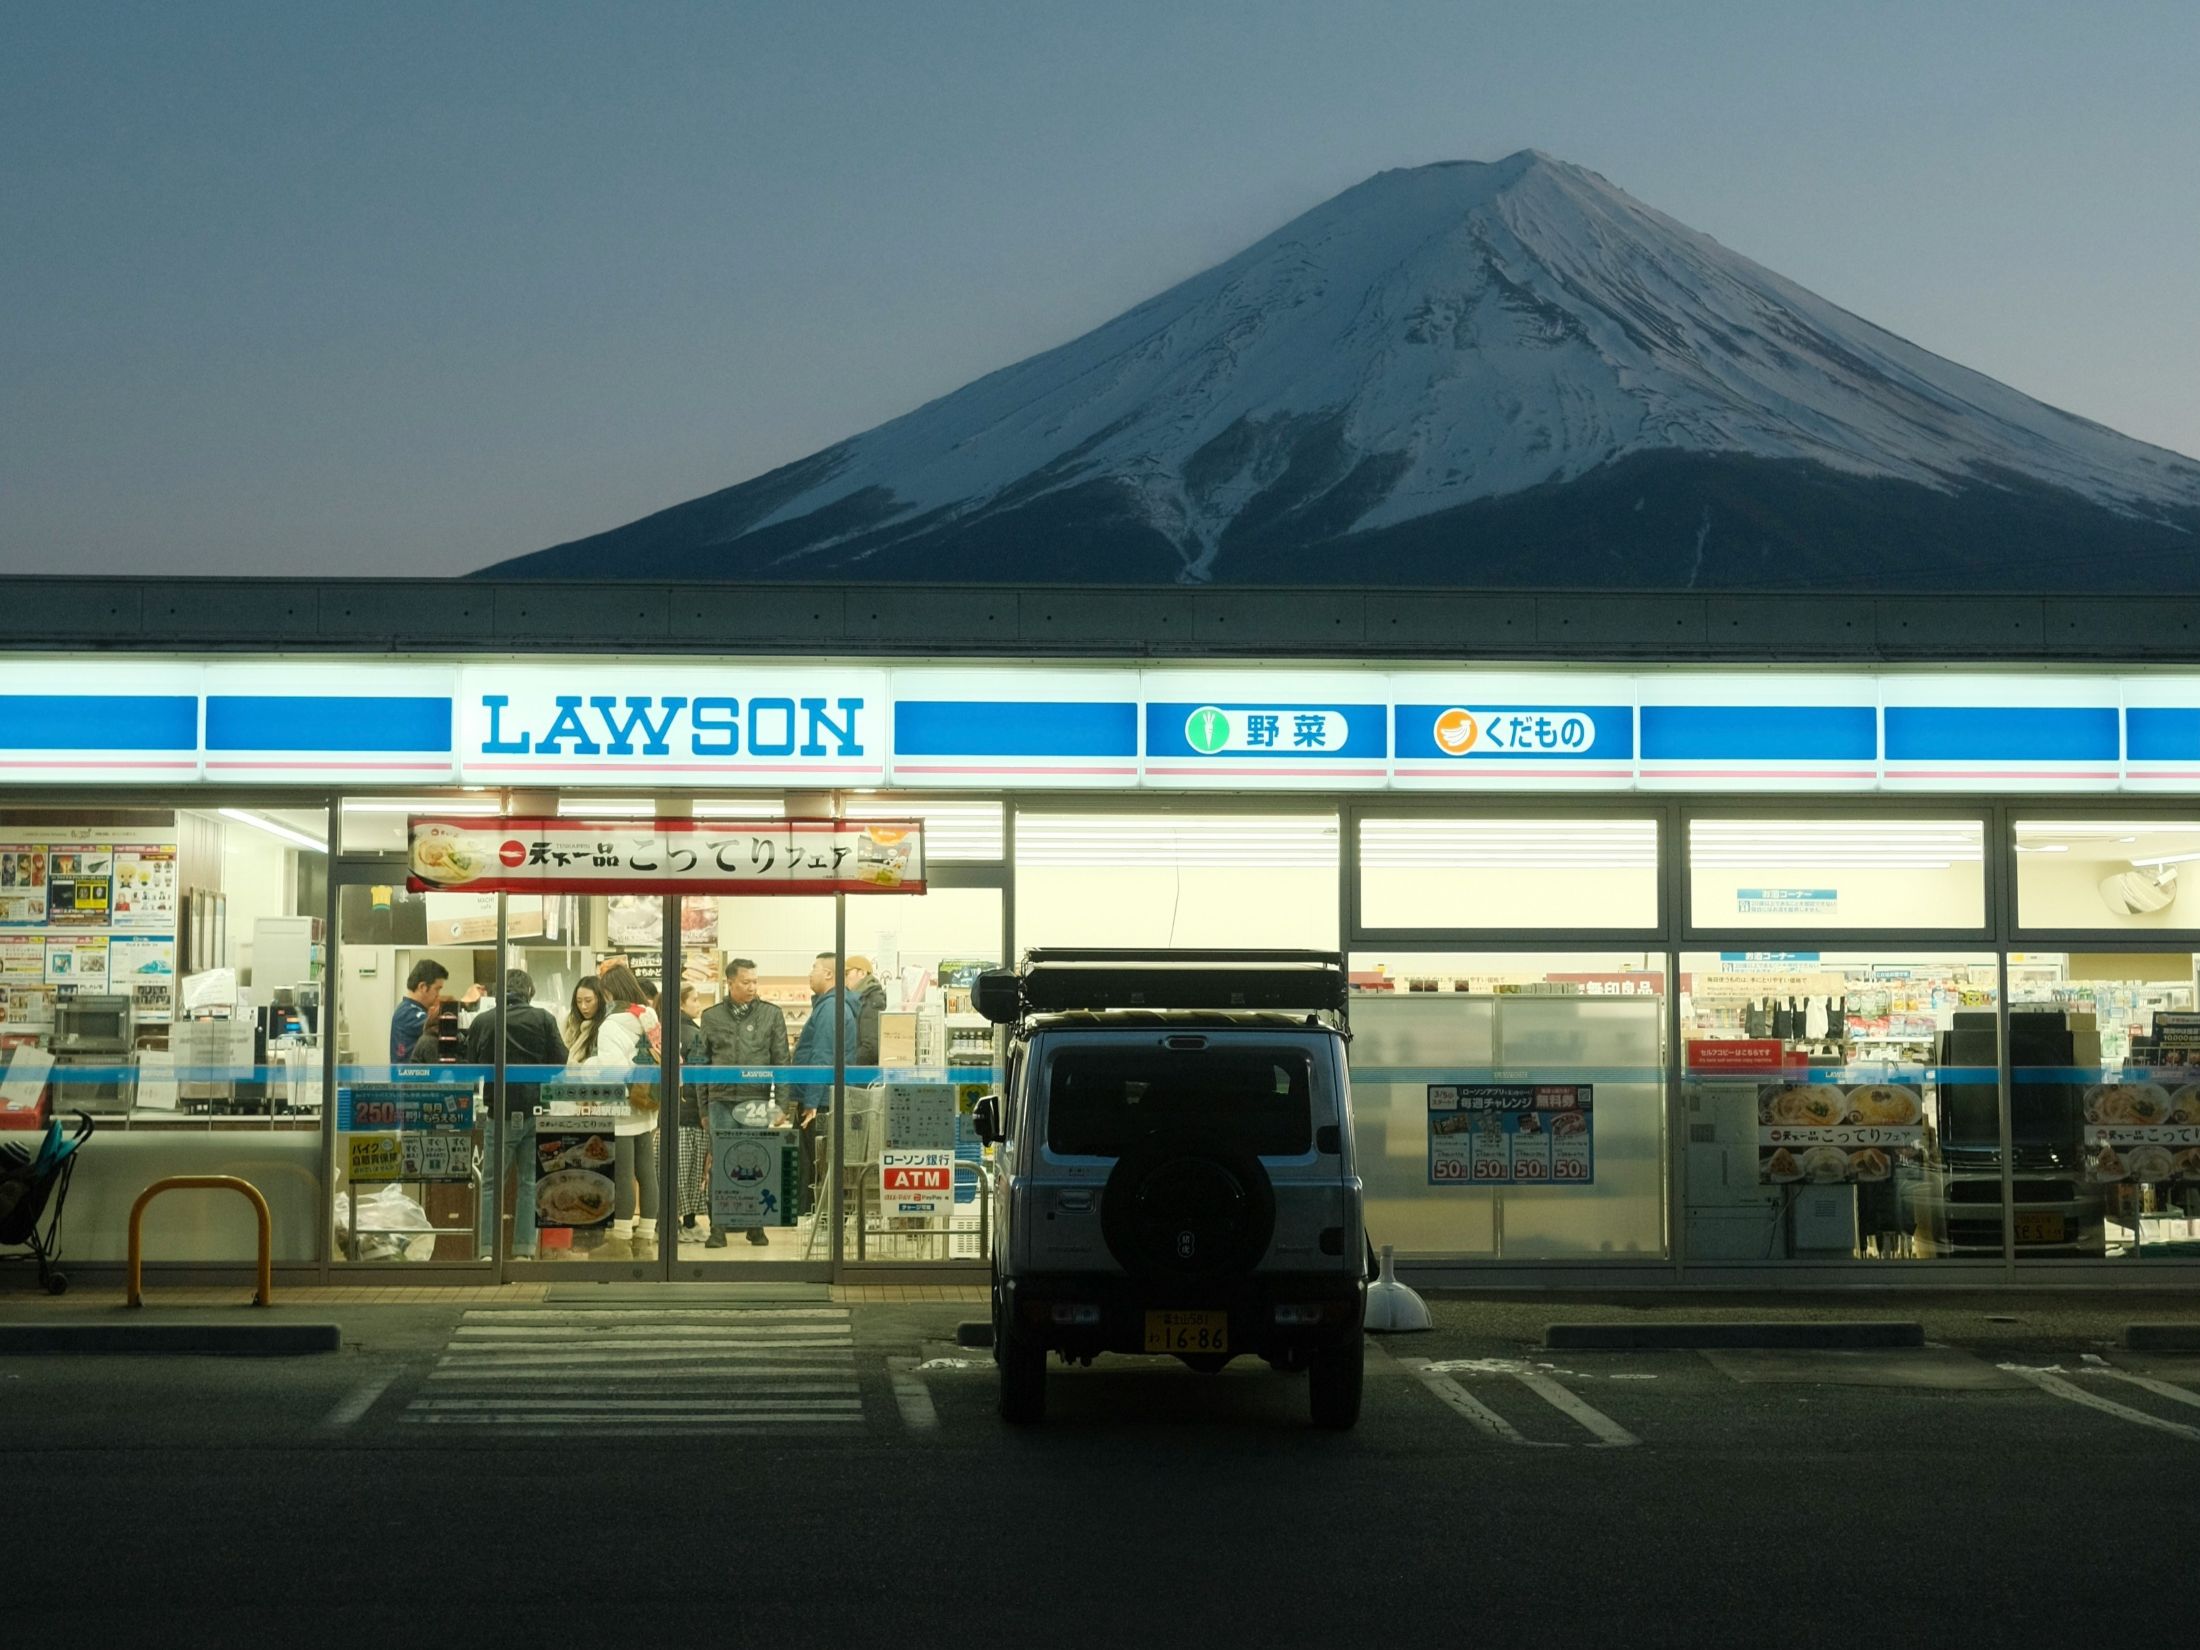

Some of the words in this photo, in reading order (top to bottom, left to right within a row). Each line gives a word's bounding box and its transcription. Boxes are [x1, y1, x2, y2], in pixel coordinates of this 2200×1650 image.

[481, 694, 864, 756] LAWSON
[1246, 714, 1326, 748] 野菜
[1485, 715, 1584, 748] くだもの
[528, 842, 620, 868] 天下一品
[1587, 980, 1653, 995] 無印良品
[741, 1070, 774, 1078] LAWSON
[1460, 1097, 1533, 1109] 毎週チャレンジ
[1536, 1095, 1576, 1108] 無料券
[745, 1102, 768, 1118] 24
[352, 1143, 380, 1155] バイク
[884, 1155, 949, 1166] ローソン銀行
[894, 1171, 940, 1187] ATM
[1165, 1327, 1223, 1349] 16-86
